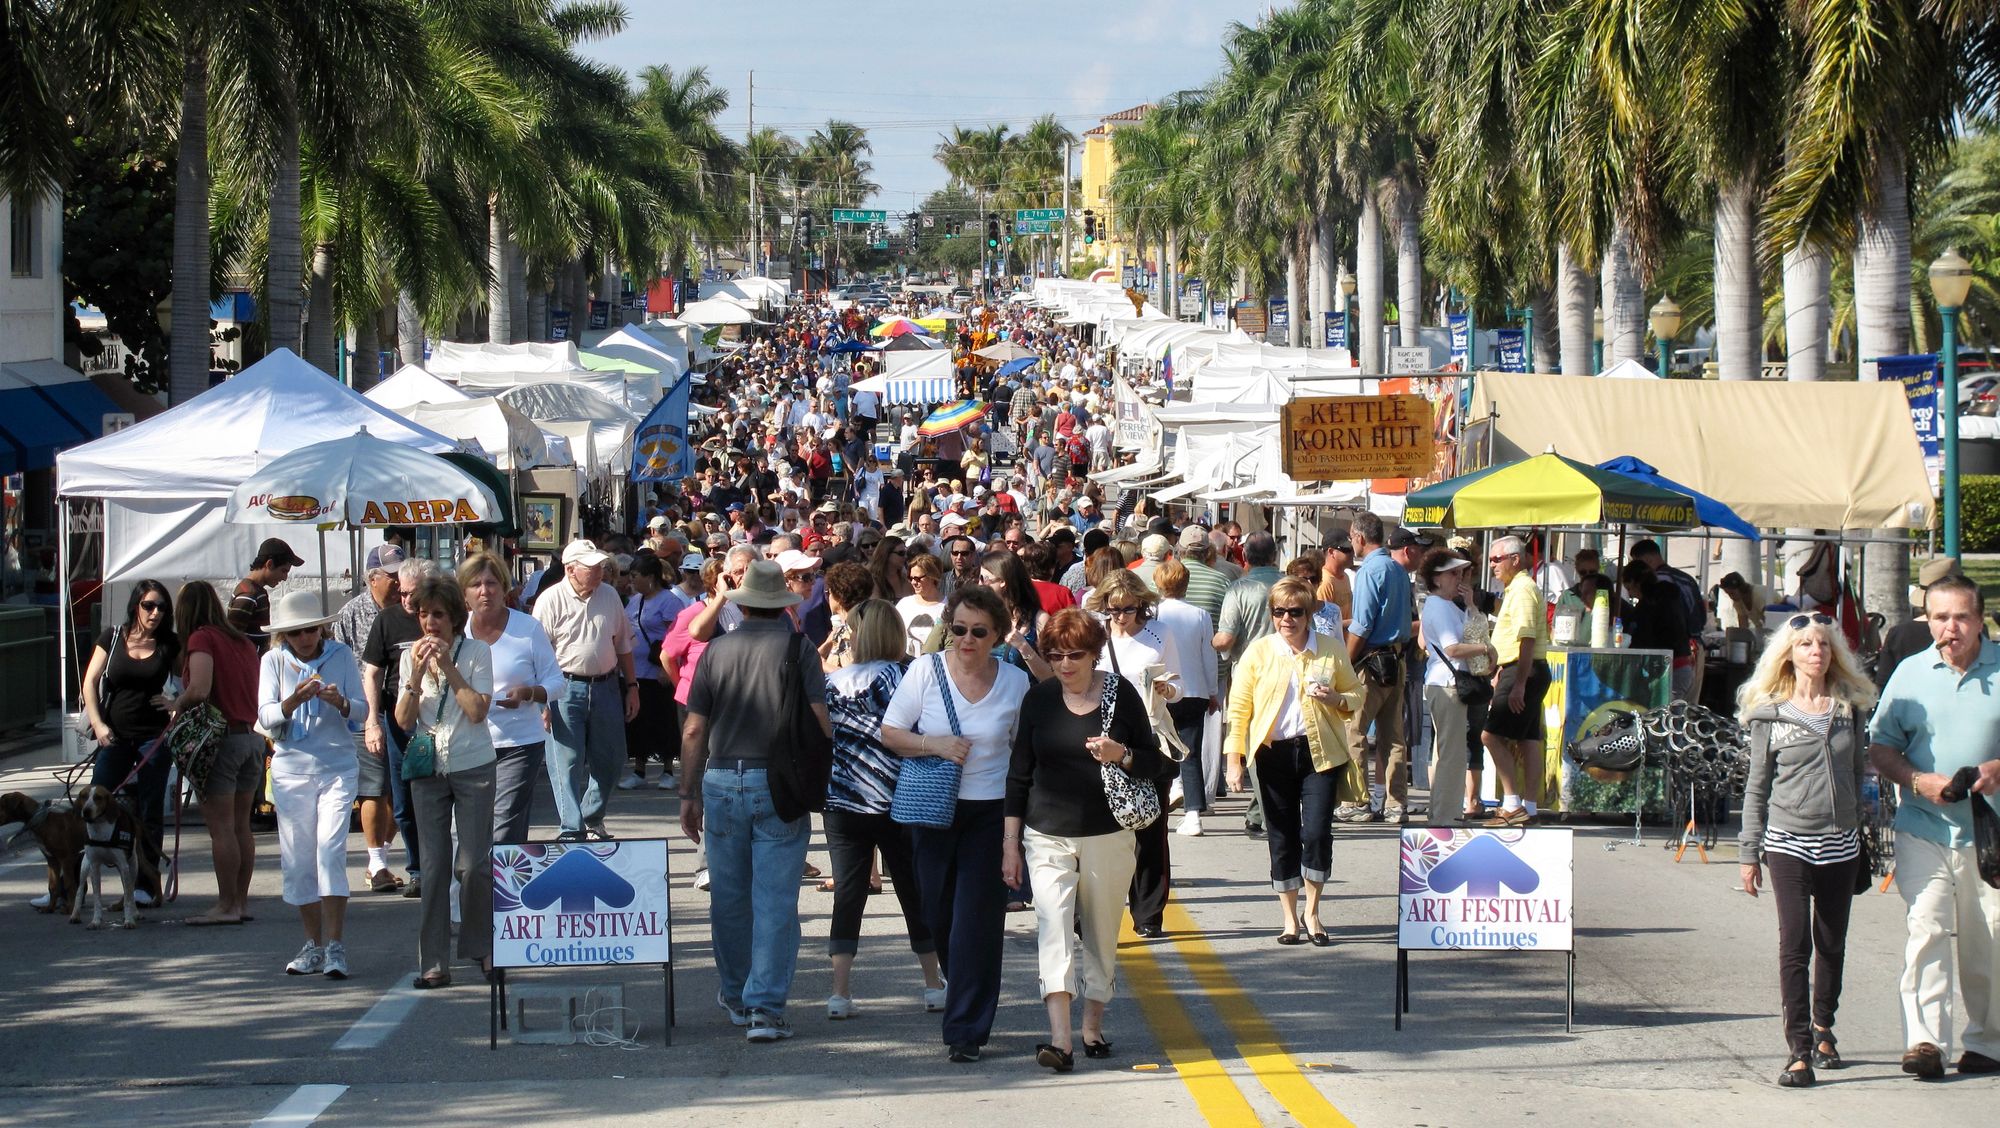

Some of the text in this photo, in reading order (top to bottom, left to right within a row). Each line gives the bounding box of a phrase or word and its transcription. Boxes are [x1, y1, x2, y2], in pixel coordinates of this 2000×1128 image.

[1310, 400, 1407, 424] KETTLE
[1911, 406, 1934, 421] ray
[1118, 422, 1151, 432] PERFECT
[1125, 431, 1145, 440] VIEW
[1293, 425, 1421, 451] KORN HUT
[1320, 452, 1373, 463] FASHIONED
[246, 494, 274, 509] All
[361, 498, 480, 524] AREPA
[1636, 504, 1693, 522] LEMONADE
[1406, 898, 1567, 923] ART FESTIVAL
[500, 911, 663, 940] ART FESTIVAL
[1430, 925, 1538, 947] Continues
[525, 940, 635, 963] Continues
